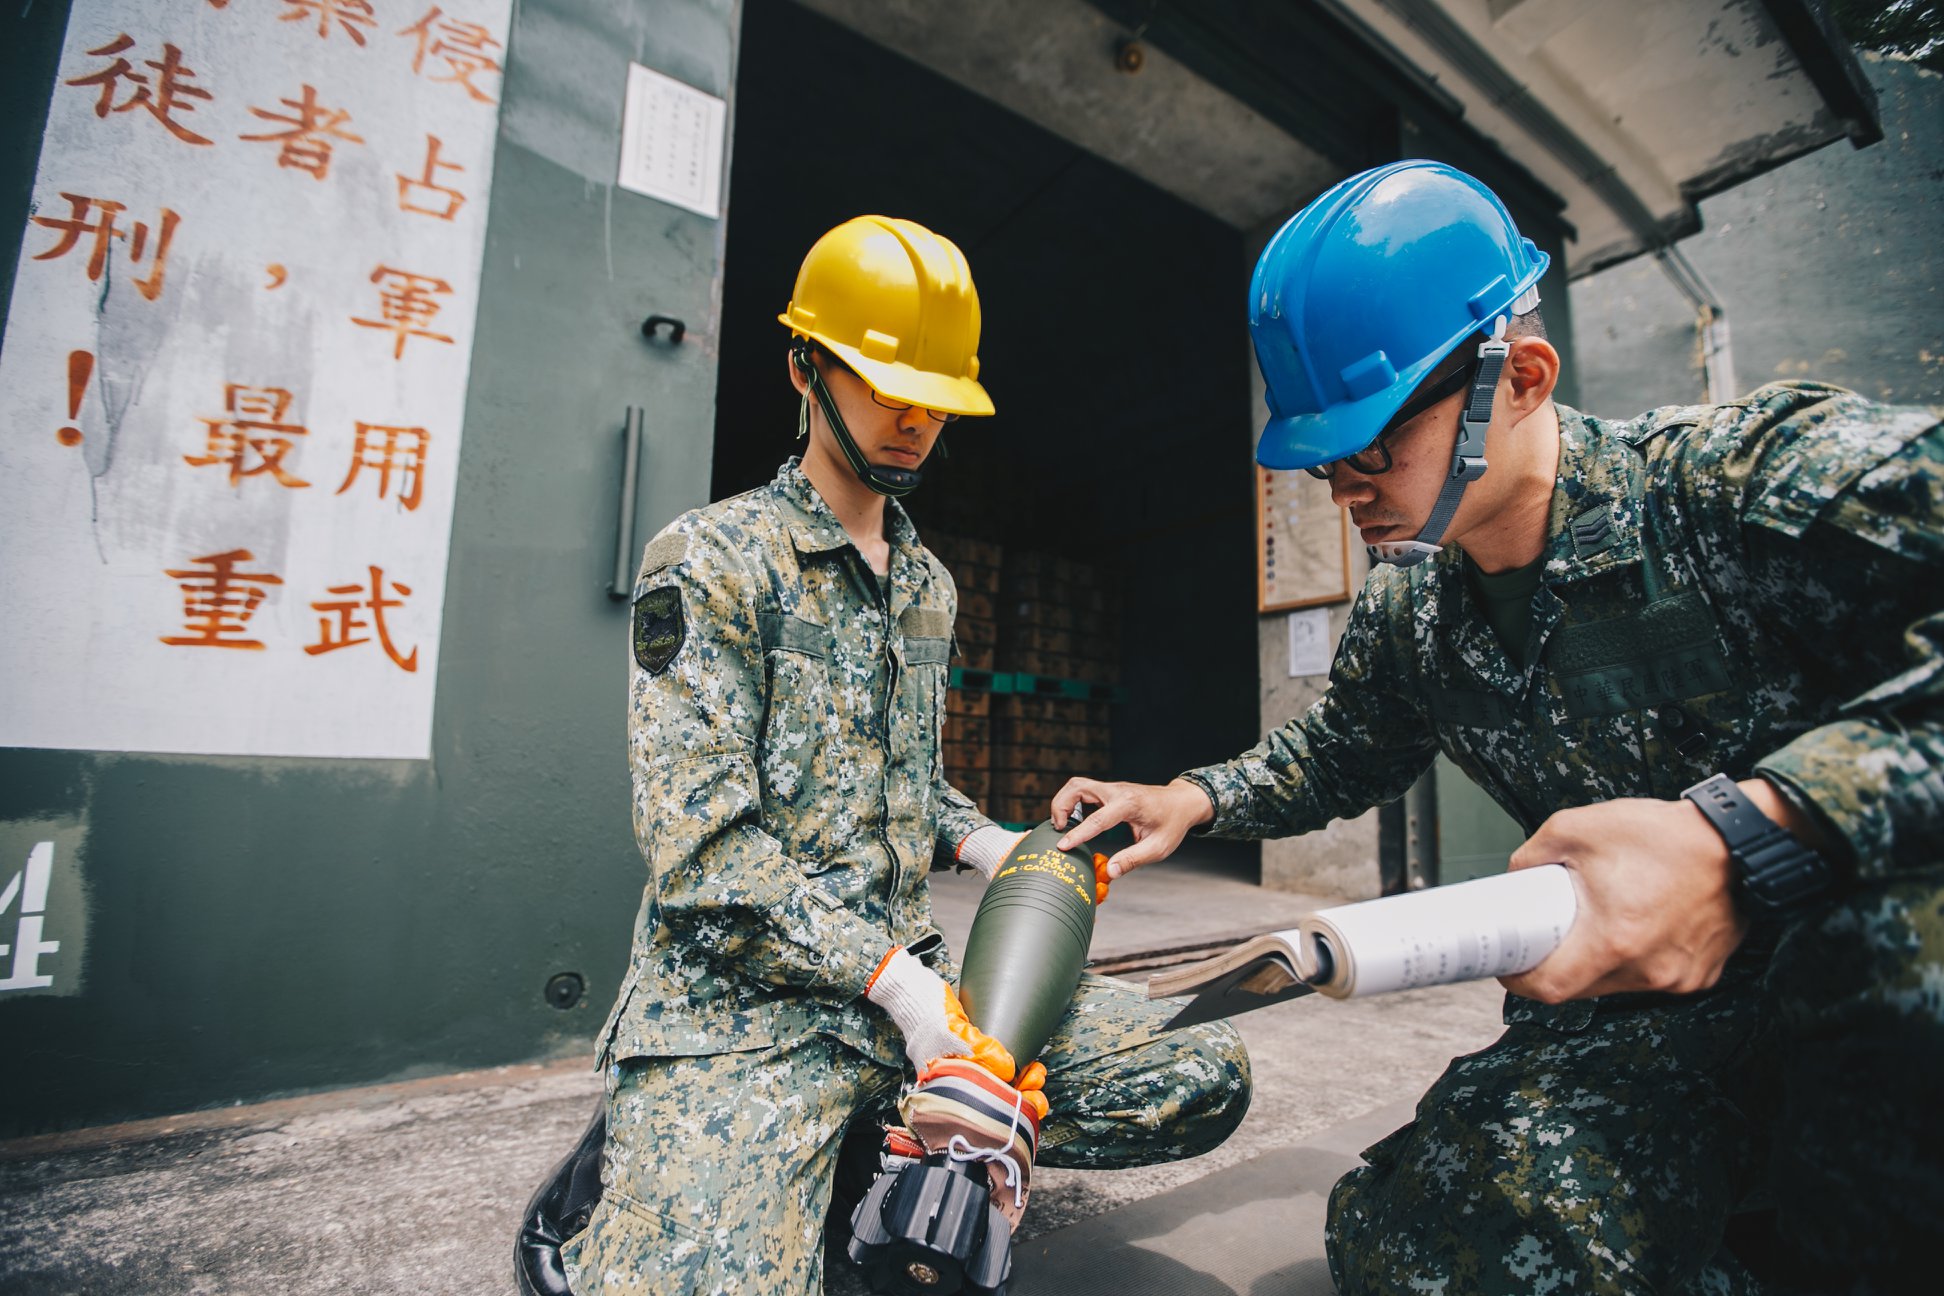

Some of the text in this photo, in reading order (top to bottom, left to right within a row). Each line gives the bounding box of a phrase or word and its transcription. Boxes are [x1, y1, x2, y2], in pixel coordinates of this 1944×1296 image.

[33, 0, 228, 447] 徒刑！
[304, 7, 502, 673] 侵占軍用武
[1573, 658, 1709, 703] 中華民國陸軍
